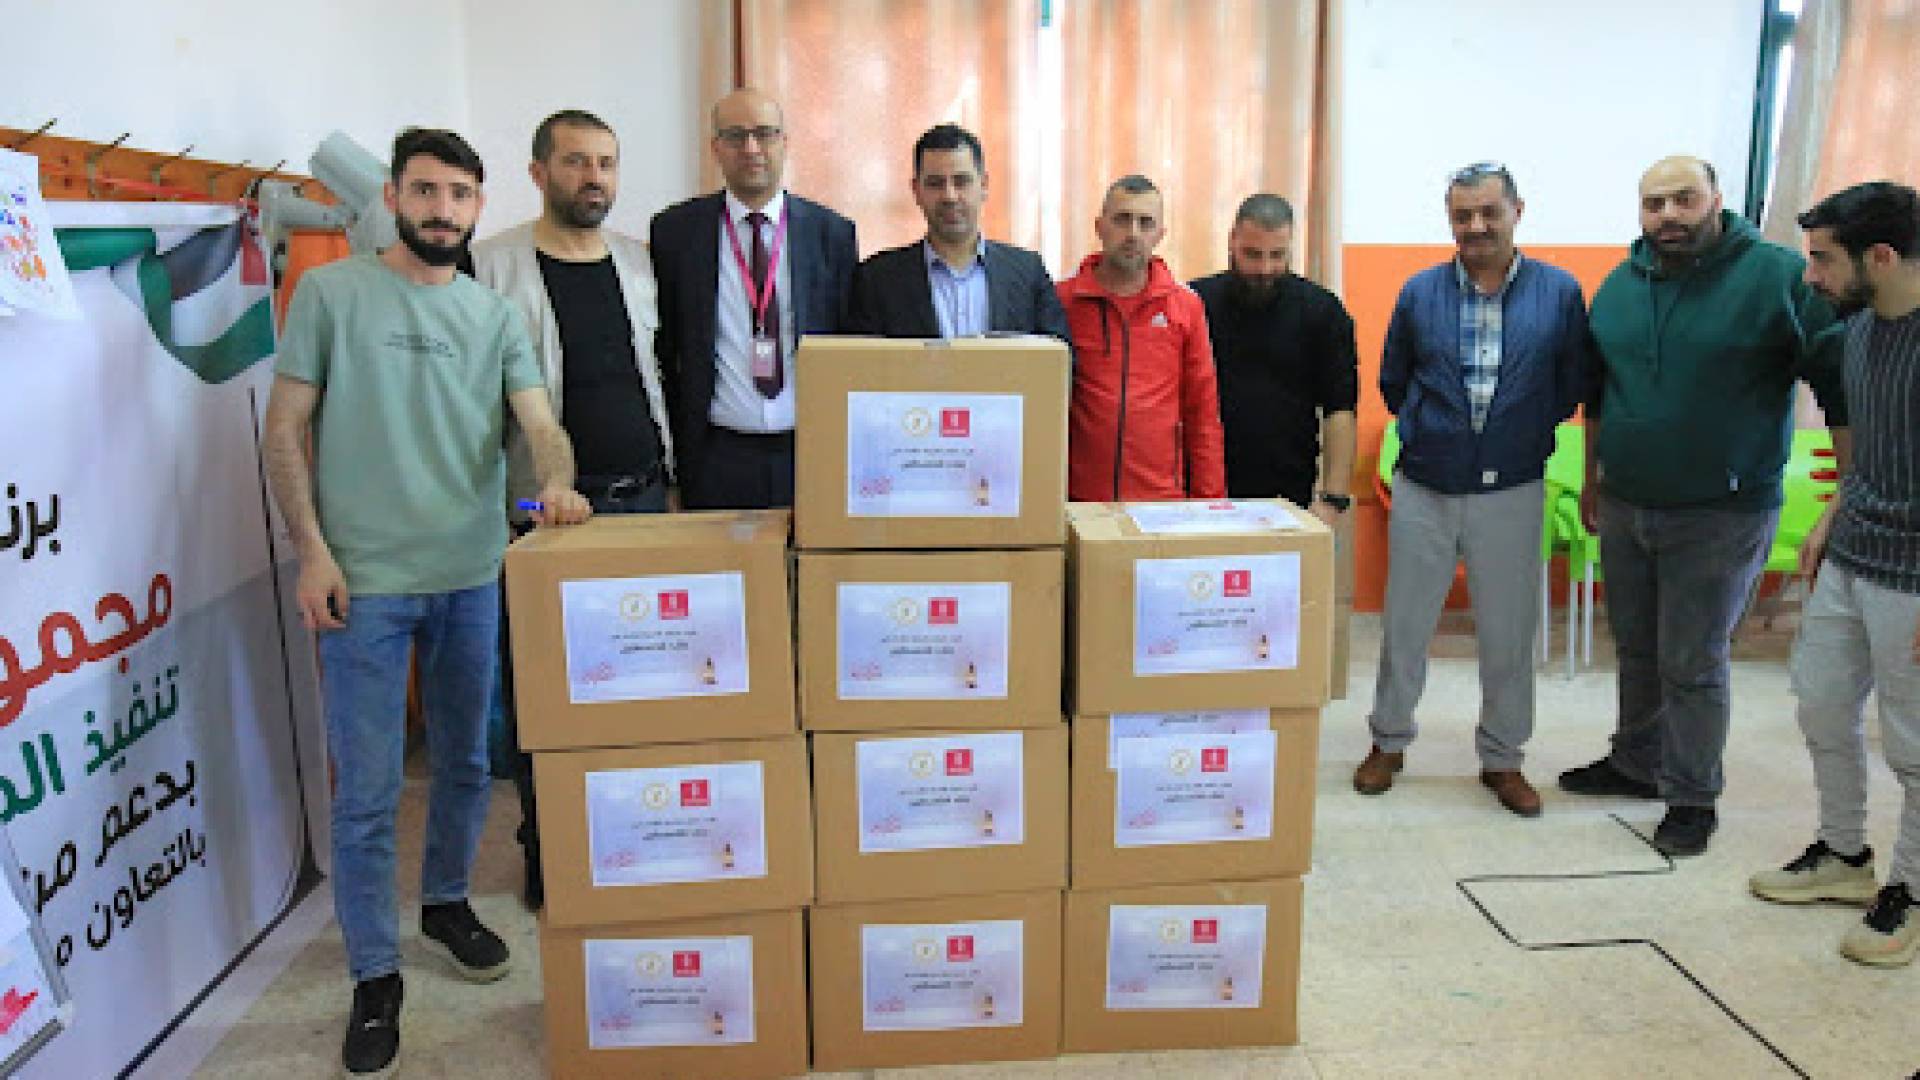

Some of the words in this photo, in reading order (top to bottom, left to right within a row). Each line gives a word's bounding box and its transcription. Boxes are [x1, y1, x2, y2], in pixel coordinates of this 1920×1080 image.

[83, 664, 180, 775] تنفيذ
[95, 760, 196, 867] بدعم
[87, 828, 206, 951] بالتعاون
